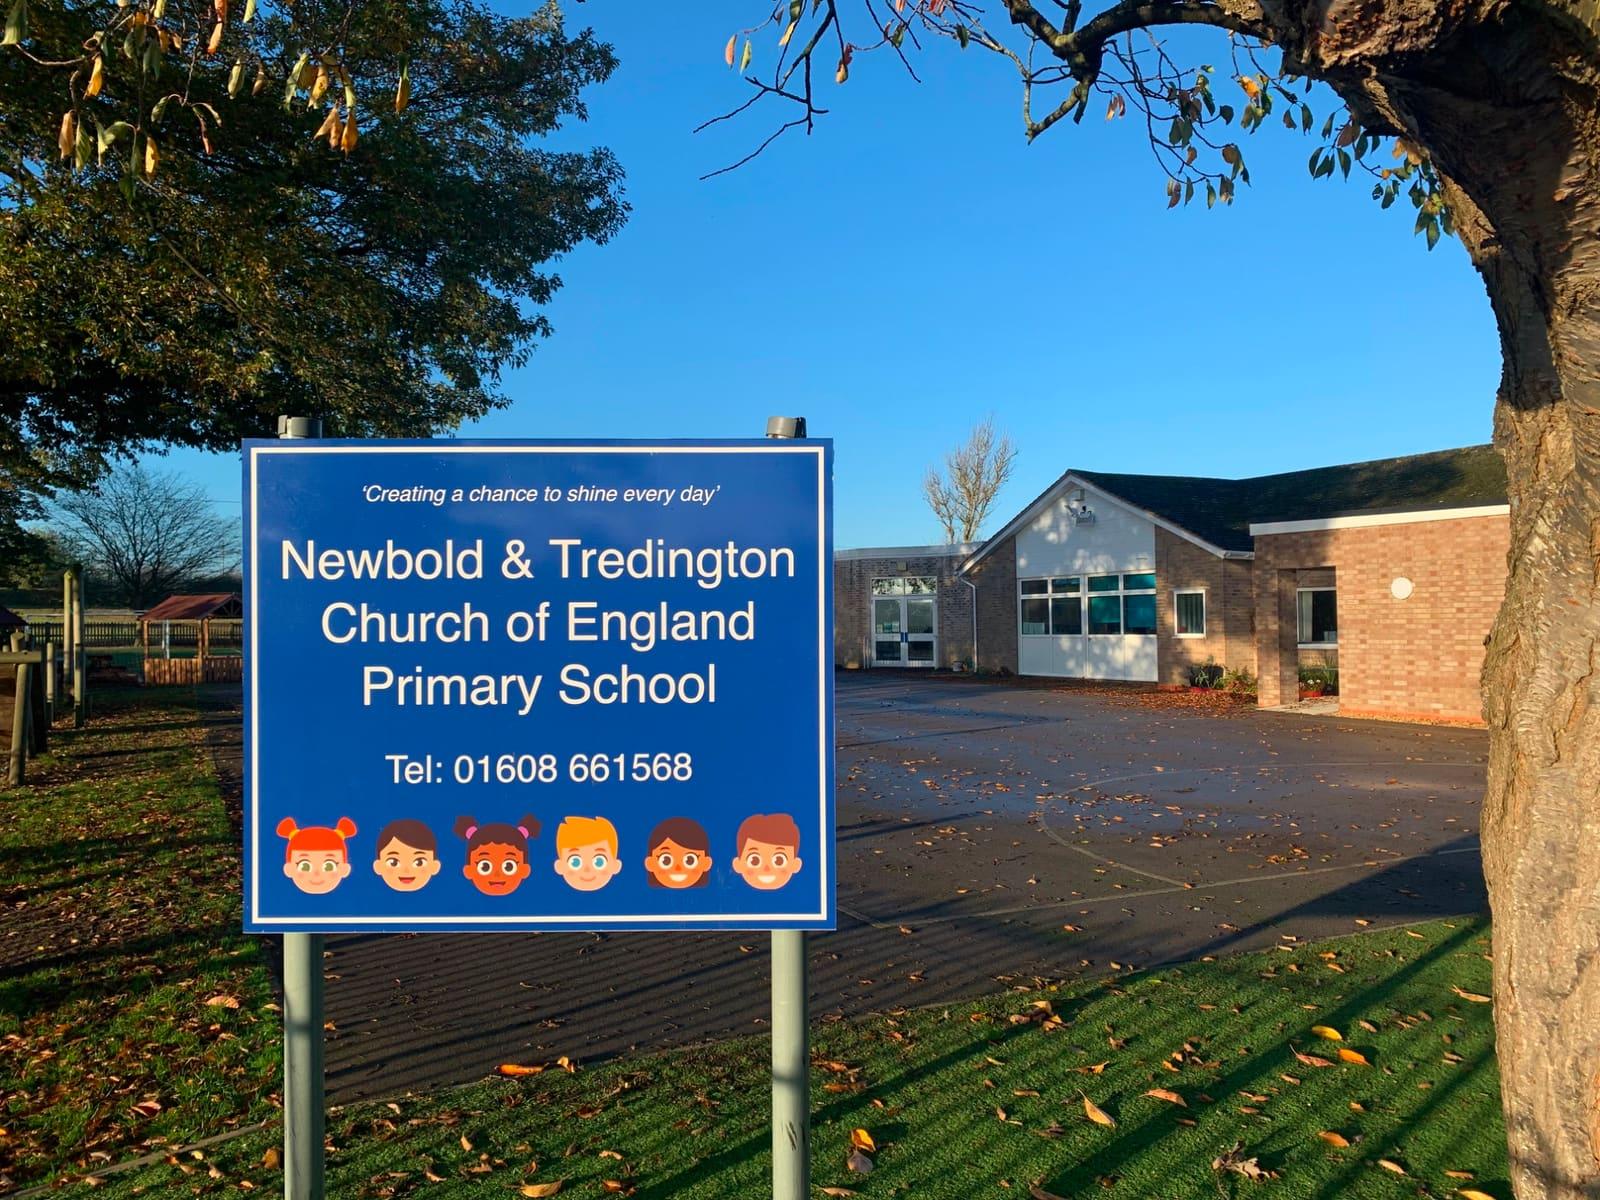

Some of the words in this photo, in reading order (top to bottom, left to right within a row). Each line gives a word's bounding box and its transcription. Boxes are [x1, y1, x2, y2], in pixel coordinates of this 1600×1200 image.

[451, 488, 464, 502] a
[469, 484, 538, 502] chance
[543, 485, 562, 502] to
[566, 484, 619, 502] shine
[623, 488, 676, 506] every
[281, 539, 483, 580] Newbold
[501, 539, 535, 580] &
[548, 538, 795, 589] Tredington
[321, 601, 489, 643] Church
[506, 601, 551, 643] of
[568, 600, 755, 652] England
[363, 665, 543, 715] Primary
[559, 663, 716, 704] School
[384, 754, 442, 785] Tel:
[454, 754, 558, 784] 01608
[569, 752, 693, 783] 661568
